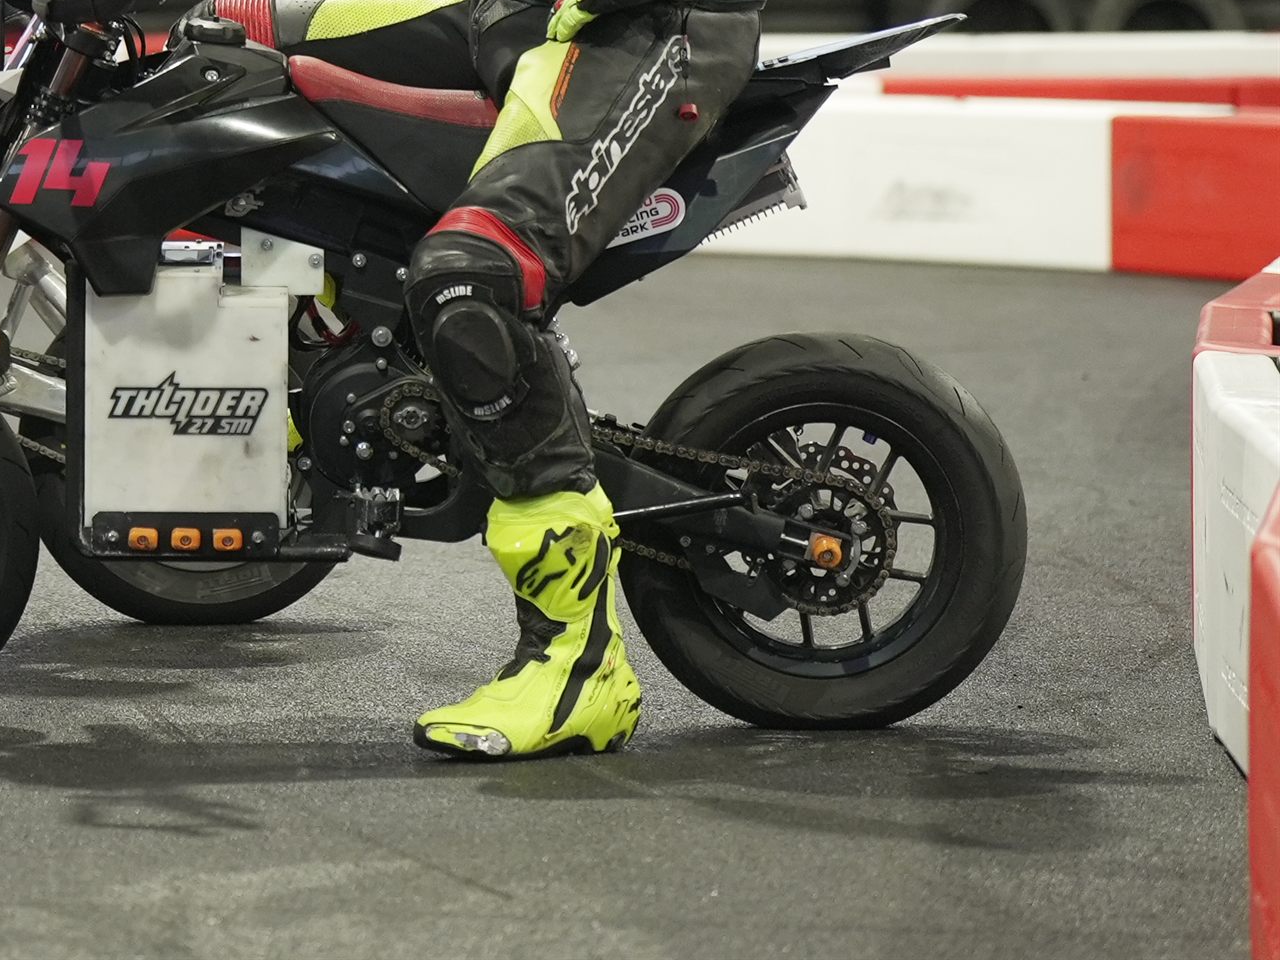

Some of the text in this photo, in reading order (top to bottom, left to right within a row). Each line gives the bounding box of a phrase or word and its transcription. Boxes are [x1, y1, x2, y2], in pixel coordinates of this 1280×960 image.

[9, 139, 109, 207] 14
[614, 222, 649, 238] aRK
[435, 285, 473, 305] mSLIDE
[110, 378, 268, 426] THUNDER
[186, 418, 215, 434] 27
